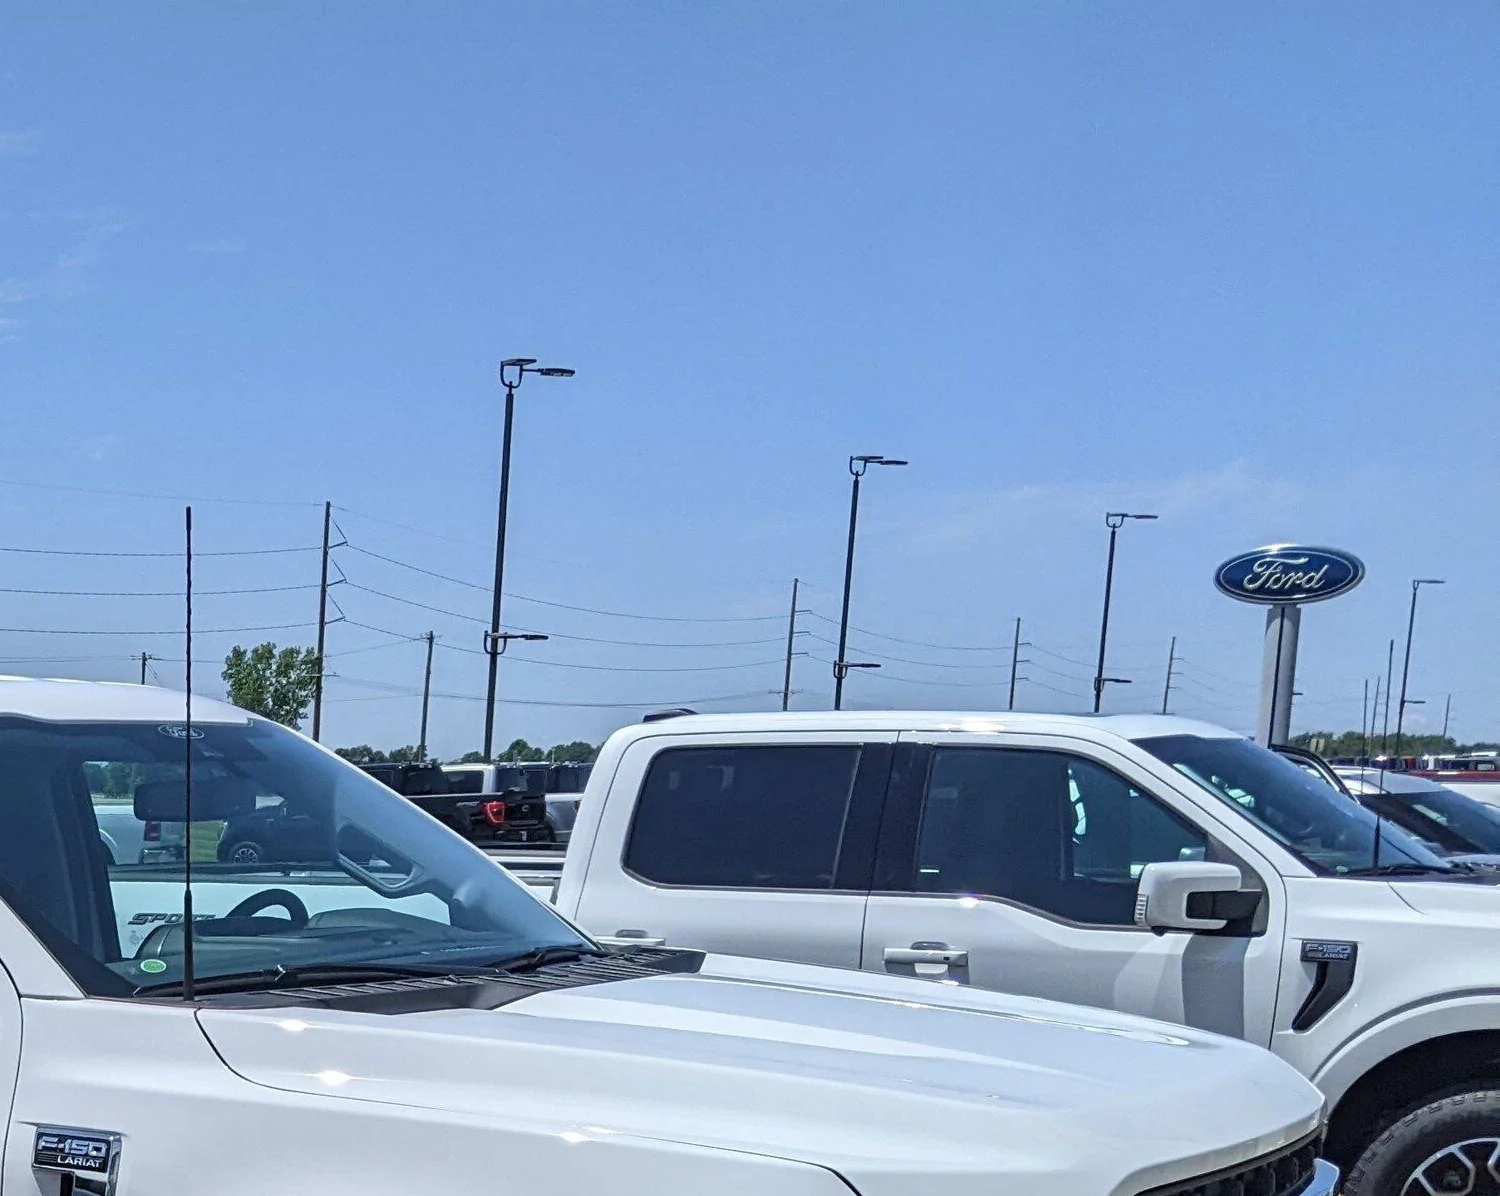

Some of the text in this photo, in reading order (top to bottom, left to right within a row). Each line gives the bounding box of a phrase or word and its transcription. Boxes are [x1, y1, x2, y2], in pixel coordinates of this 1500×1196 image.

[1243, 557, 1329, 590] Ford
[1305, 944, 1352, 953] F-150
[37, 1135, 108, 1157] F-150
[57, 1155, 104, 1168] LARIAT
